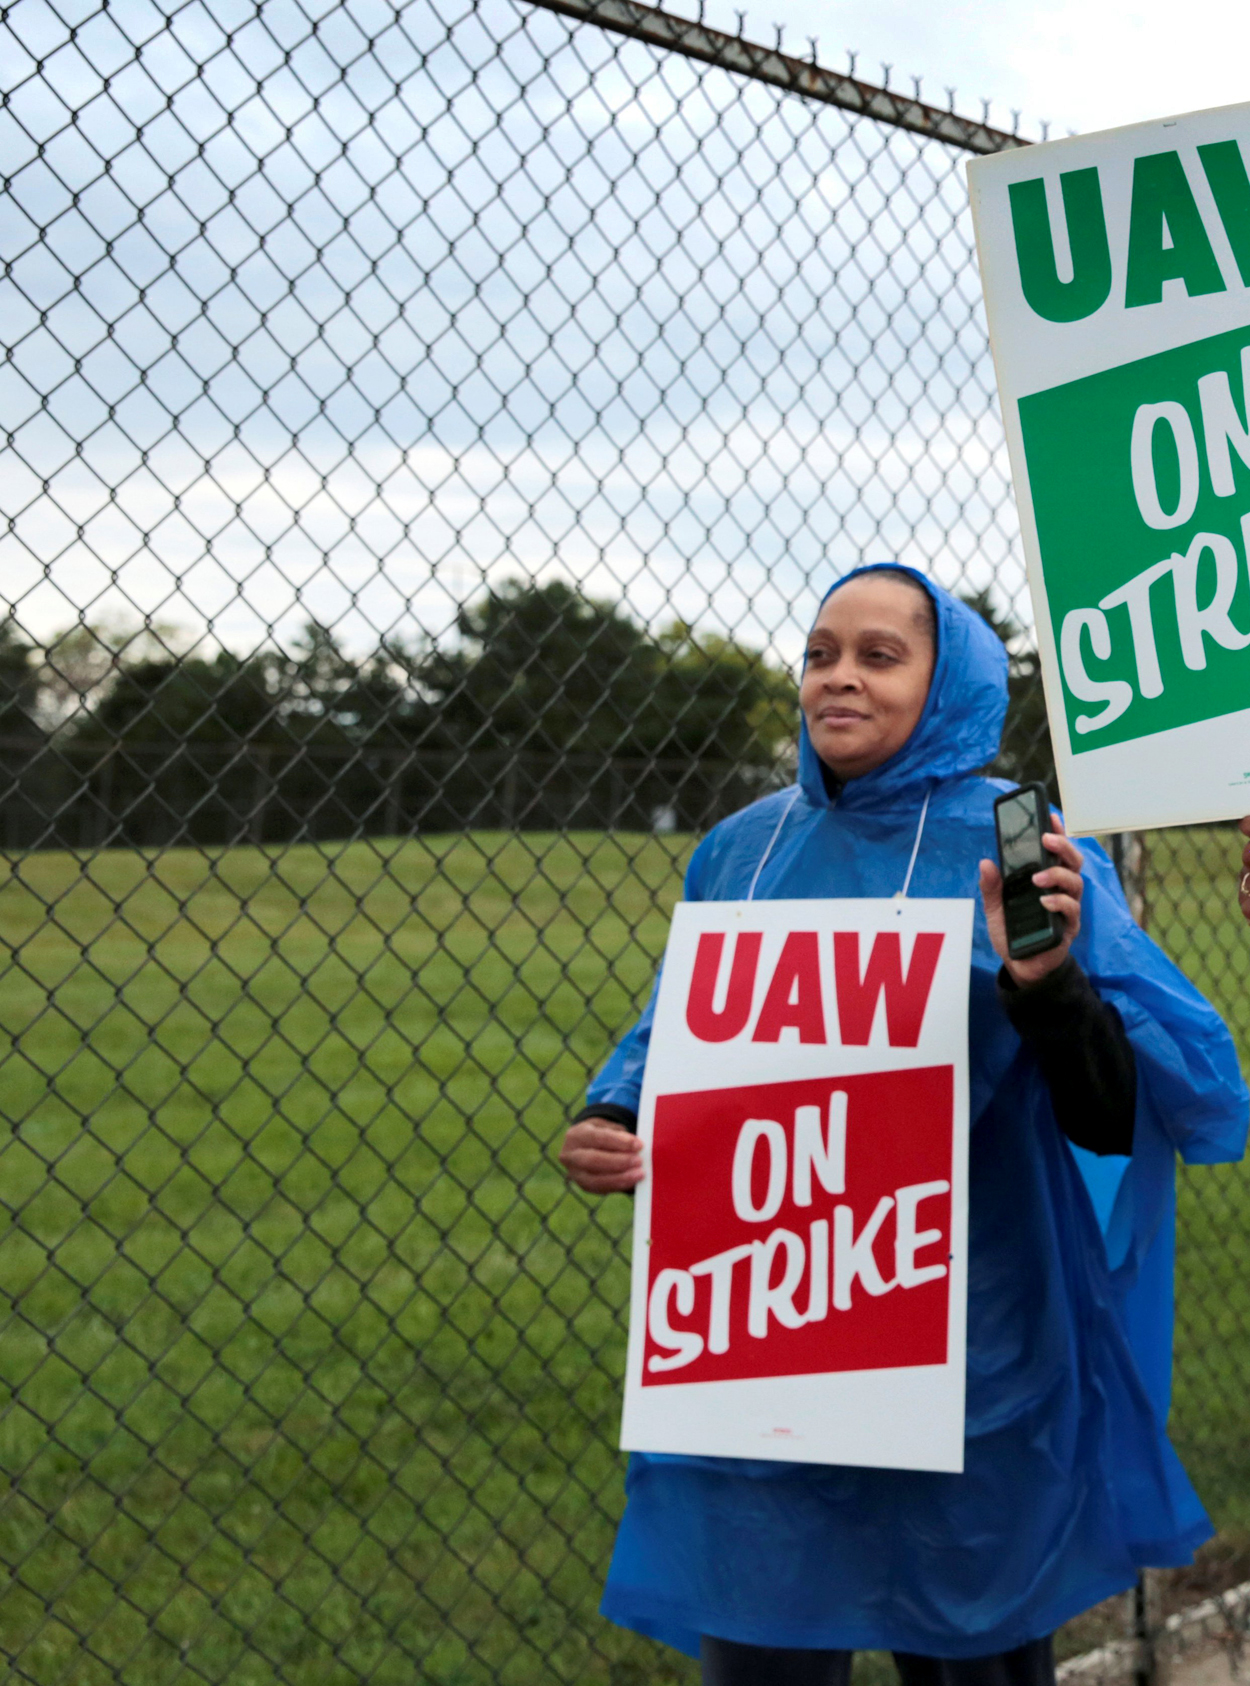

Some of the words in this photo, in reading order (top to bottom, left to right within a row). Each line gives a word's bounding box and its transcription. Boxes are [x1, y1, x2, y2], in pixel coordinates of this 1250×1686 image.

[686, 932, 945, 1048] UAW
[731, 1090, 849, 1223] ON
[648, 1180, 951, 1373] STRIKE
